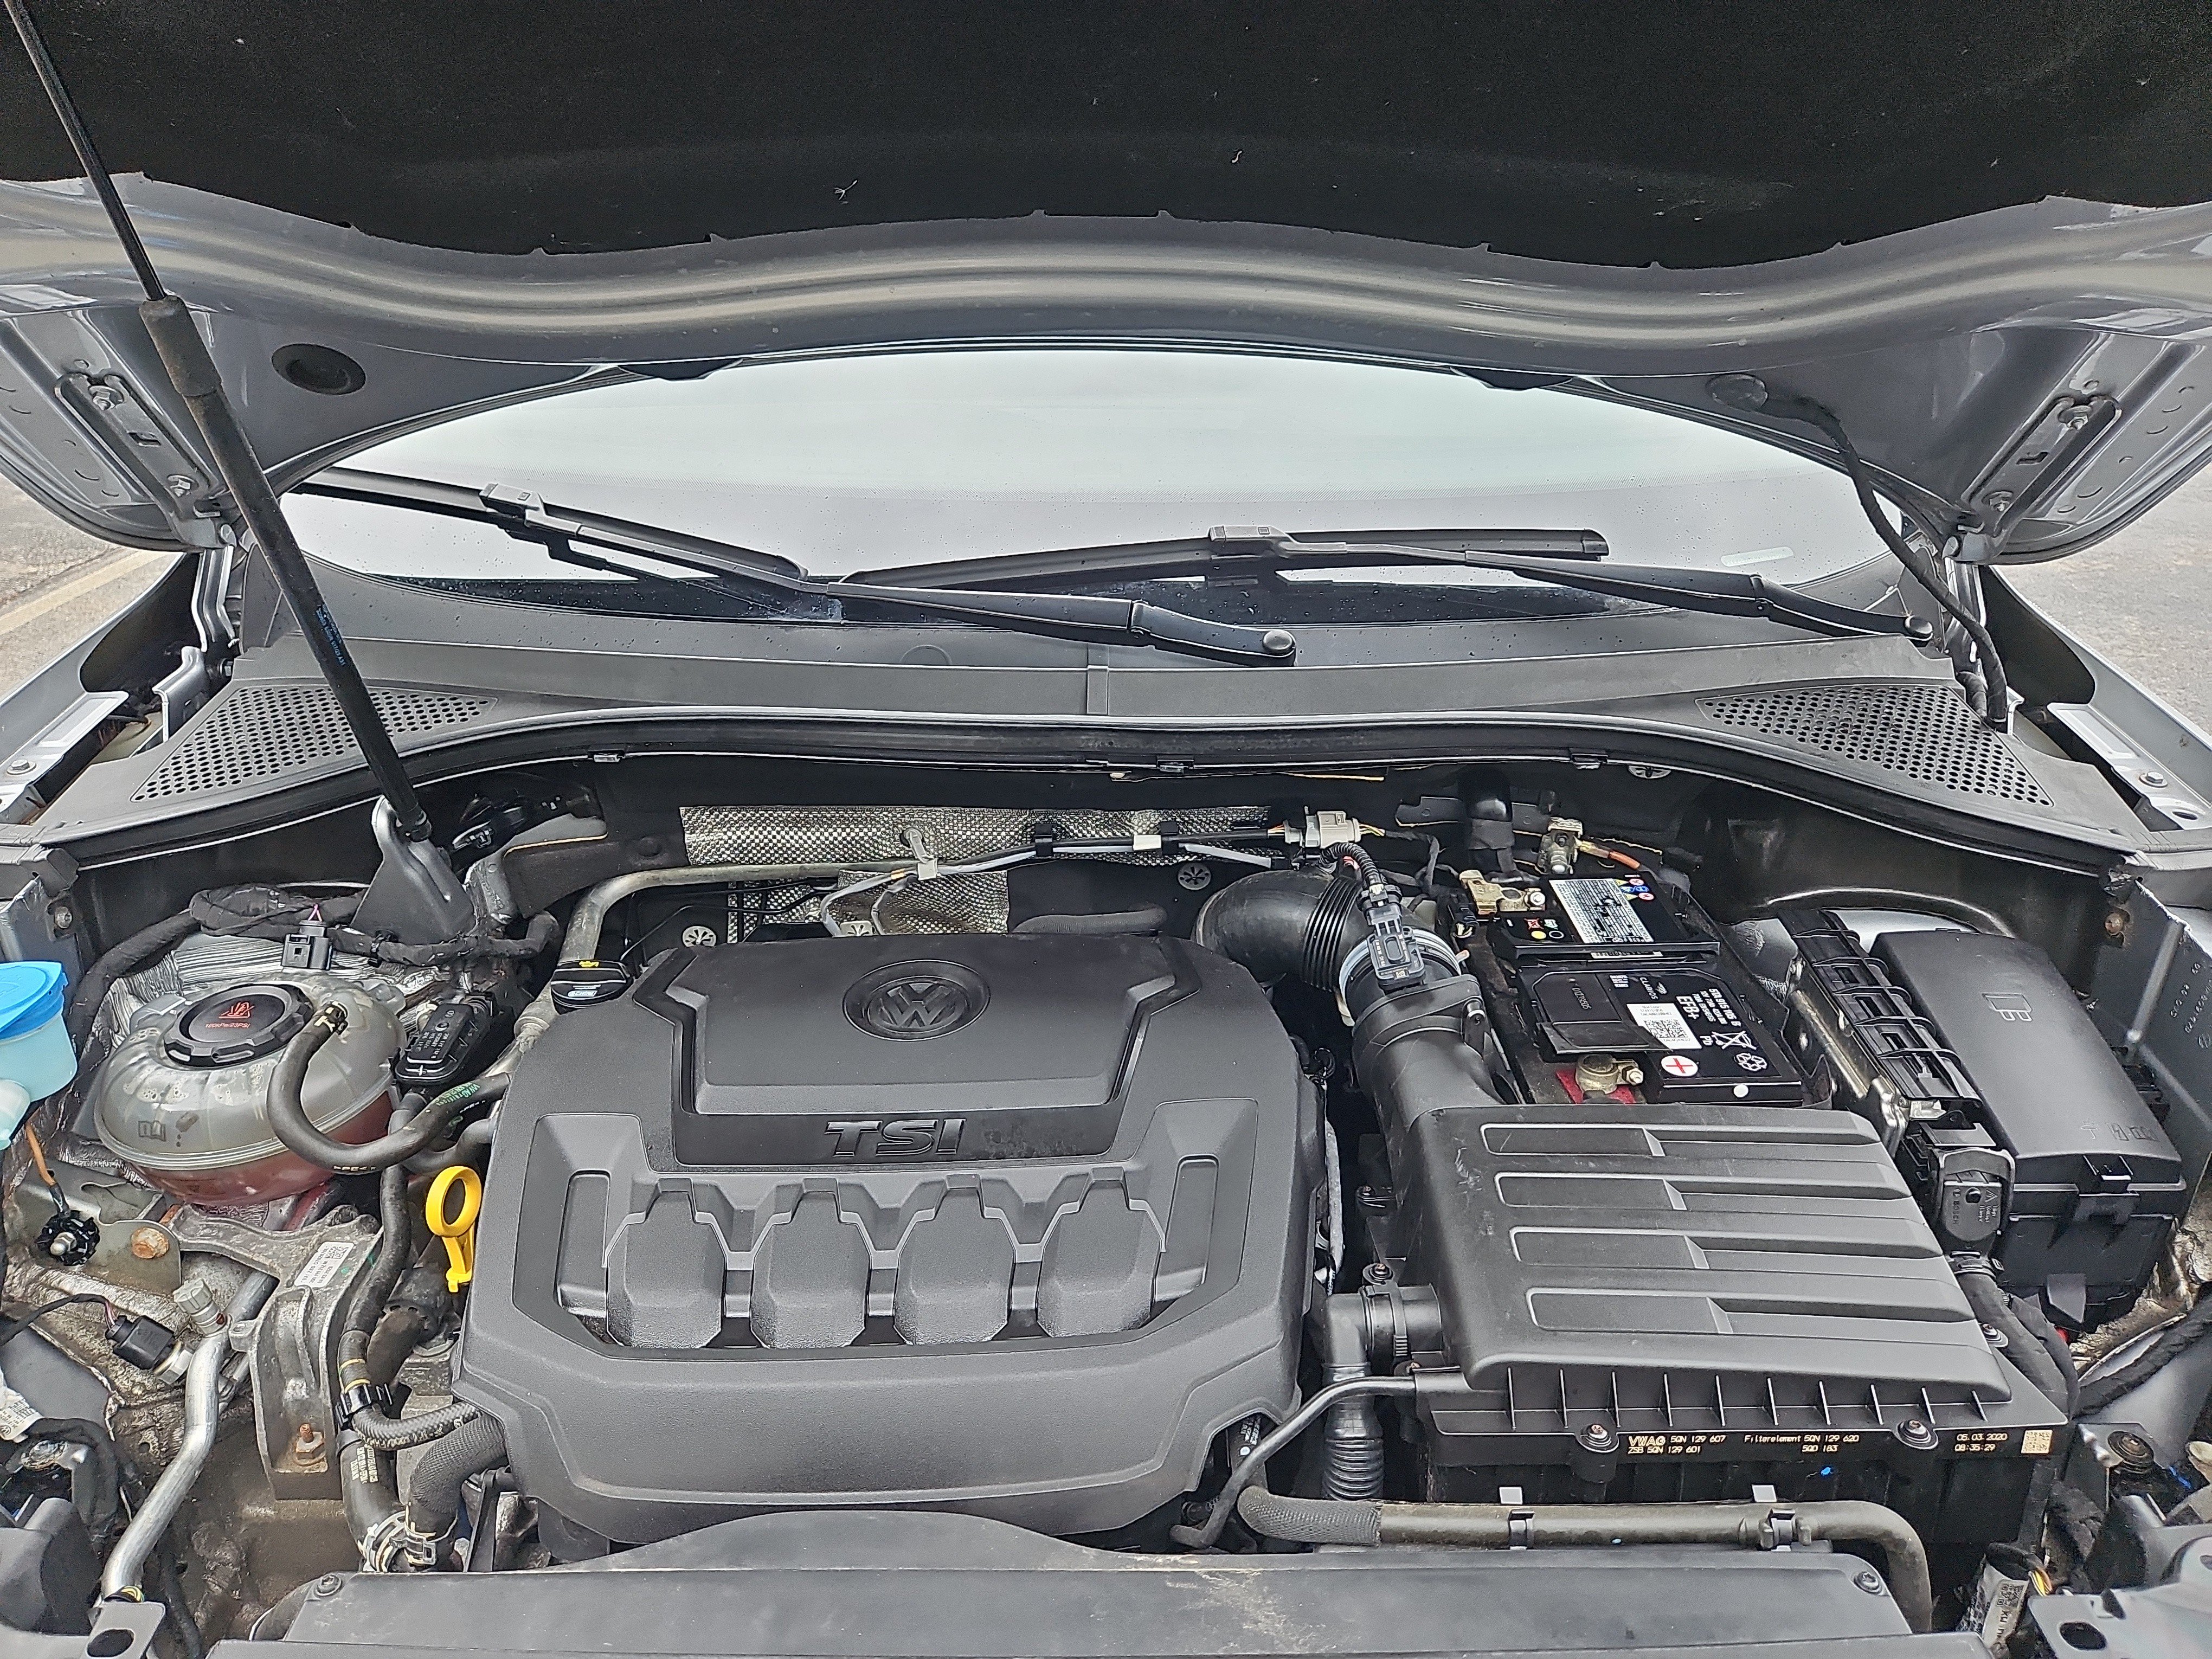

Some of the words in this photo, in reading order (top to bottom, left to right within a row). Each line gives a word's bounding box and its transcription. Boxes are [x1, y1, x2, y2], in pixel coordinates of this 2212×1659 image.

[1639, 977, 1659, 1000] CLARIOS
[1676, 996, 1700, 1020] EFB+
[1708, 988, 1722, 998] 5TA
[1715, 998, 1730, 1009] 915
[1723, 1009, 1737, 1020] 105
[1699, 1036, 1714, 1046] Pb
[824, 1118, 967, 1158] TSI
[1628, 1435, 1666, 1446] VWAG
[1709, 1435, 1726, 1443] 607
[1744, 1435, 1802, 1443] Filterelement
[1954, 1443, 1996, 1451] 08:35:29
